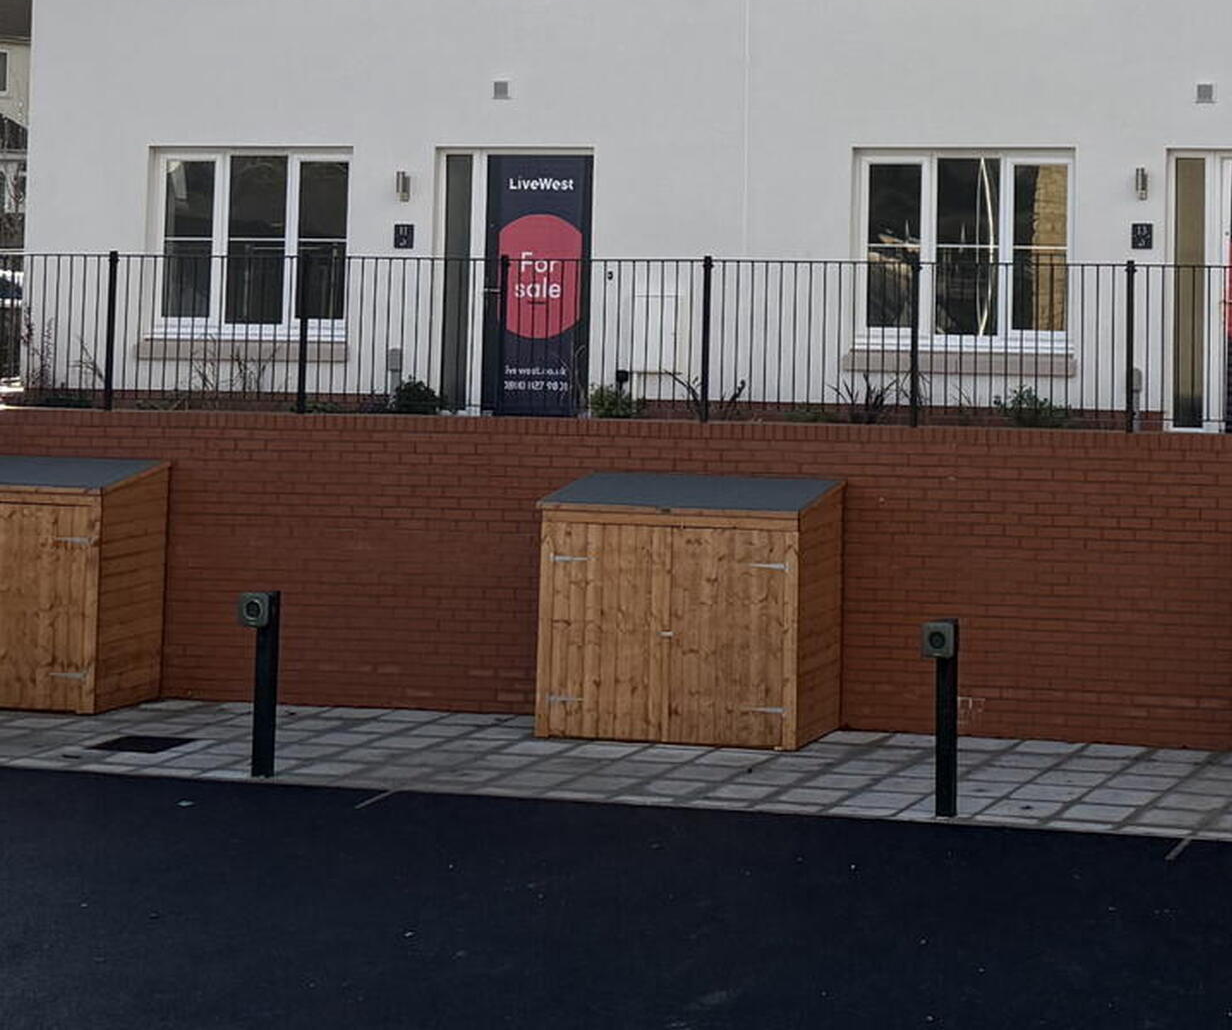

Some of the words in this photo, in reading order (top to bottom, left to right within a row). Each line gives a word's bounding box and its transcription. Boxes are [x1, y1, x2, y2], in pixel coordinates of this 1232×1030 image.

[509, 178, 574, 191] LiveWest
[520, 251, 556, 273] For
[515, 278, 561, 299] sale
